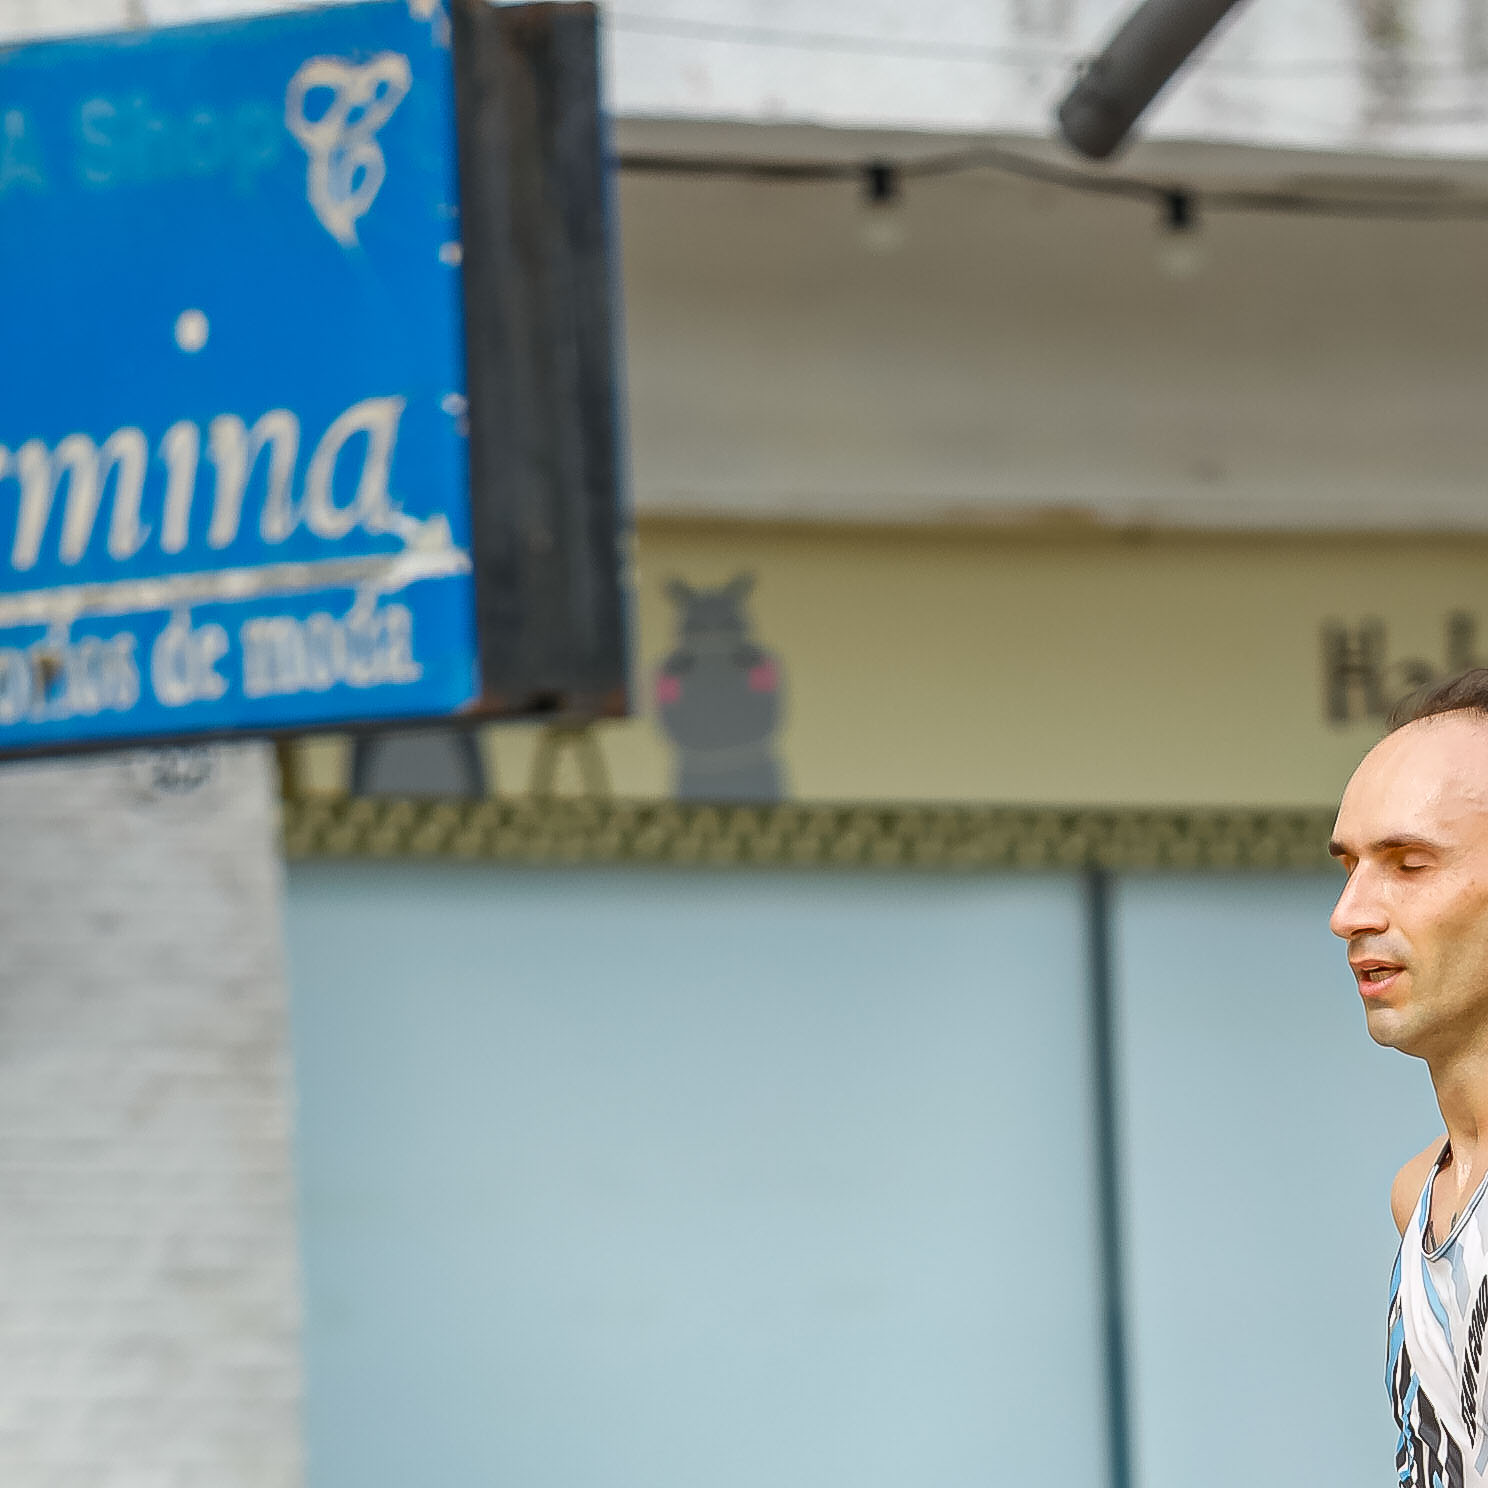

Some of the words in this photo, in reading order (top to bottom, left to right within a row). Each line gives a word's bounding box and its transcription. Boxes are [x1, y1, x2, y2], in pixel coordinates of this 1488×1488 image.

[0, 393, 412, 572] mina
[151, 604, 230, 708] de
[240, 592, 424, 699] moda
